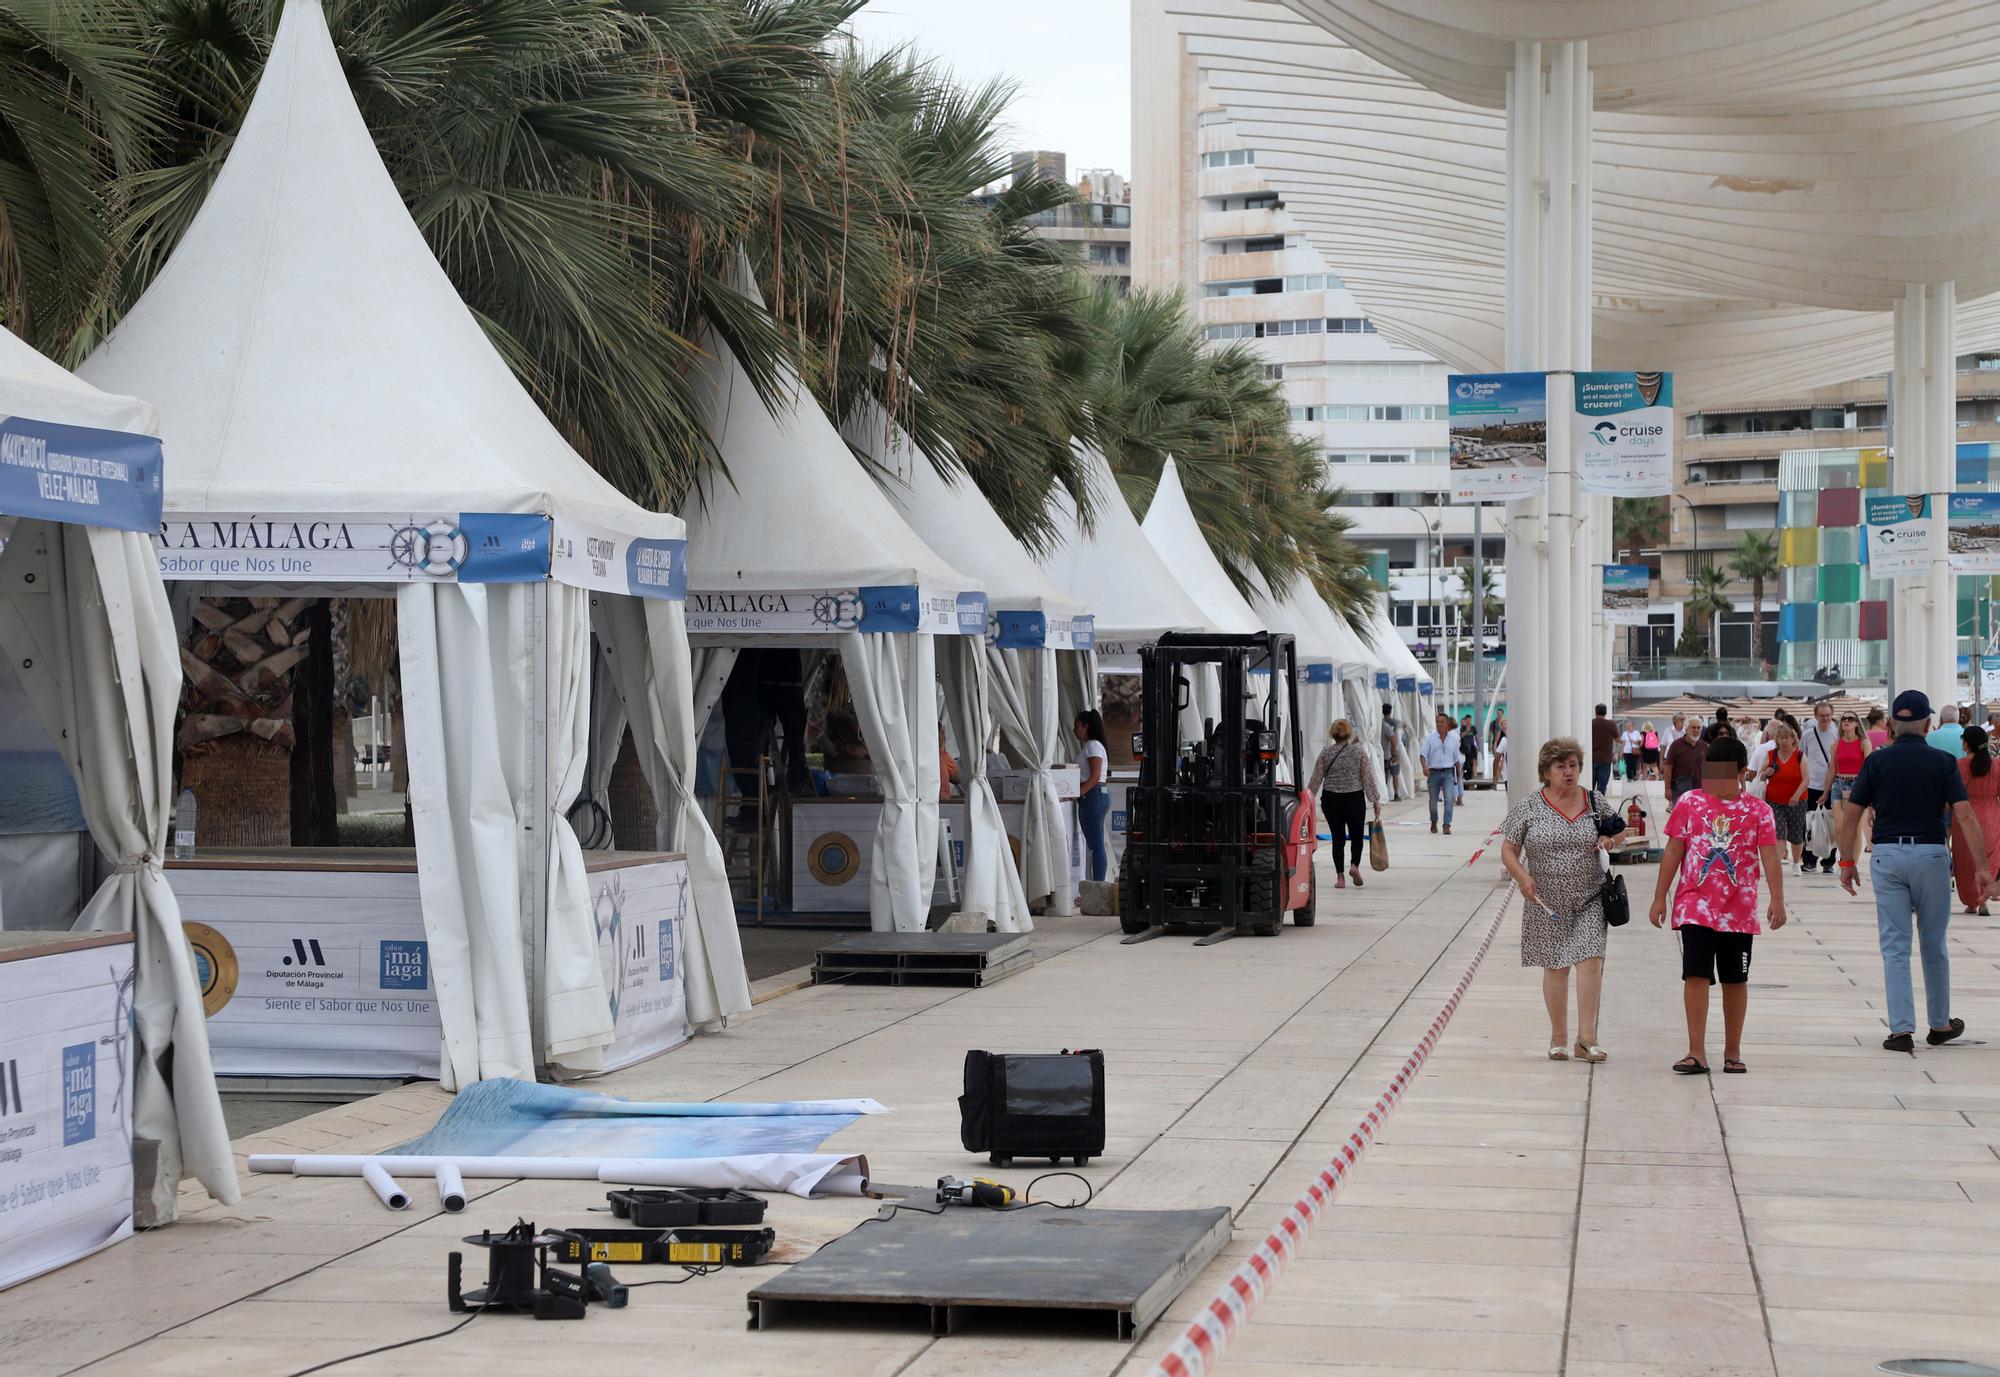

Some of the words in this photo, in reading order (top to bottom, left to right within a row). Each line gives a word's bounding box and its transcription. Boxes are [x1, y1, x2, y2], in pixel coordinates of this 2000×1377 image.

[1582, 382, 1634, 393] ¡Sumérgete
[1583, 400, 1622, 409] crucero!
[1620, 425, 1663, 437] cruise
[1629, 435, 1655, 448] days
[179, 522, 201, 548] A
[211, 515, 355, 549] MÁLAGA
[1896, 529, 1927, 539] cruise
[160, 556, 205, 572] Sabor
[210, 560, 240, 575] que
[246, 557, 276, 572] Nos
[281, 557, 312, 573] Une
[695, 591, 790, 613] MÁLAGA
[693, 619, 714, 629] que
[717, 618, 738, 628] Nos
[741, 618, 762, 628] Une
[391, 946, 423, 965] má
[266, 970, 307, 979] Diputación
[307, 971, 344, 979] Provincial
[385, 959, 423, 981] laga
[296, 980, 324, 989] Málaga
[265, 997, 301, 1010] Siente
[305, 998, 315, 1010] el
[319, 998, 352, 1011] Sabor
[355, 1001, 377, 1014] que
[381, 1000, 403, 1012] Nos
[407, 1001, 430, 1013] Une
[70, 1054, 92, 1092] má
[66, 1086, 93, 1126] laga
[20, 1180, 46, 1206] Sabor
[596, 1250, 608, 1259] 3
